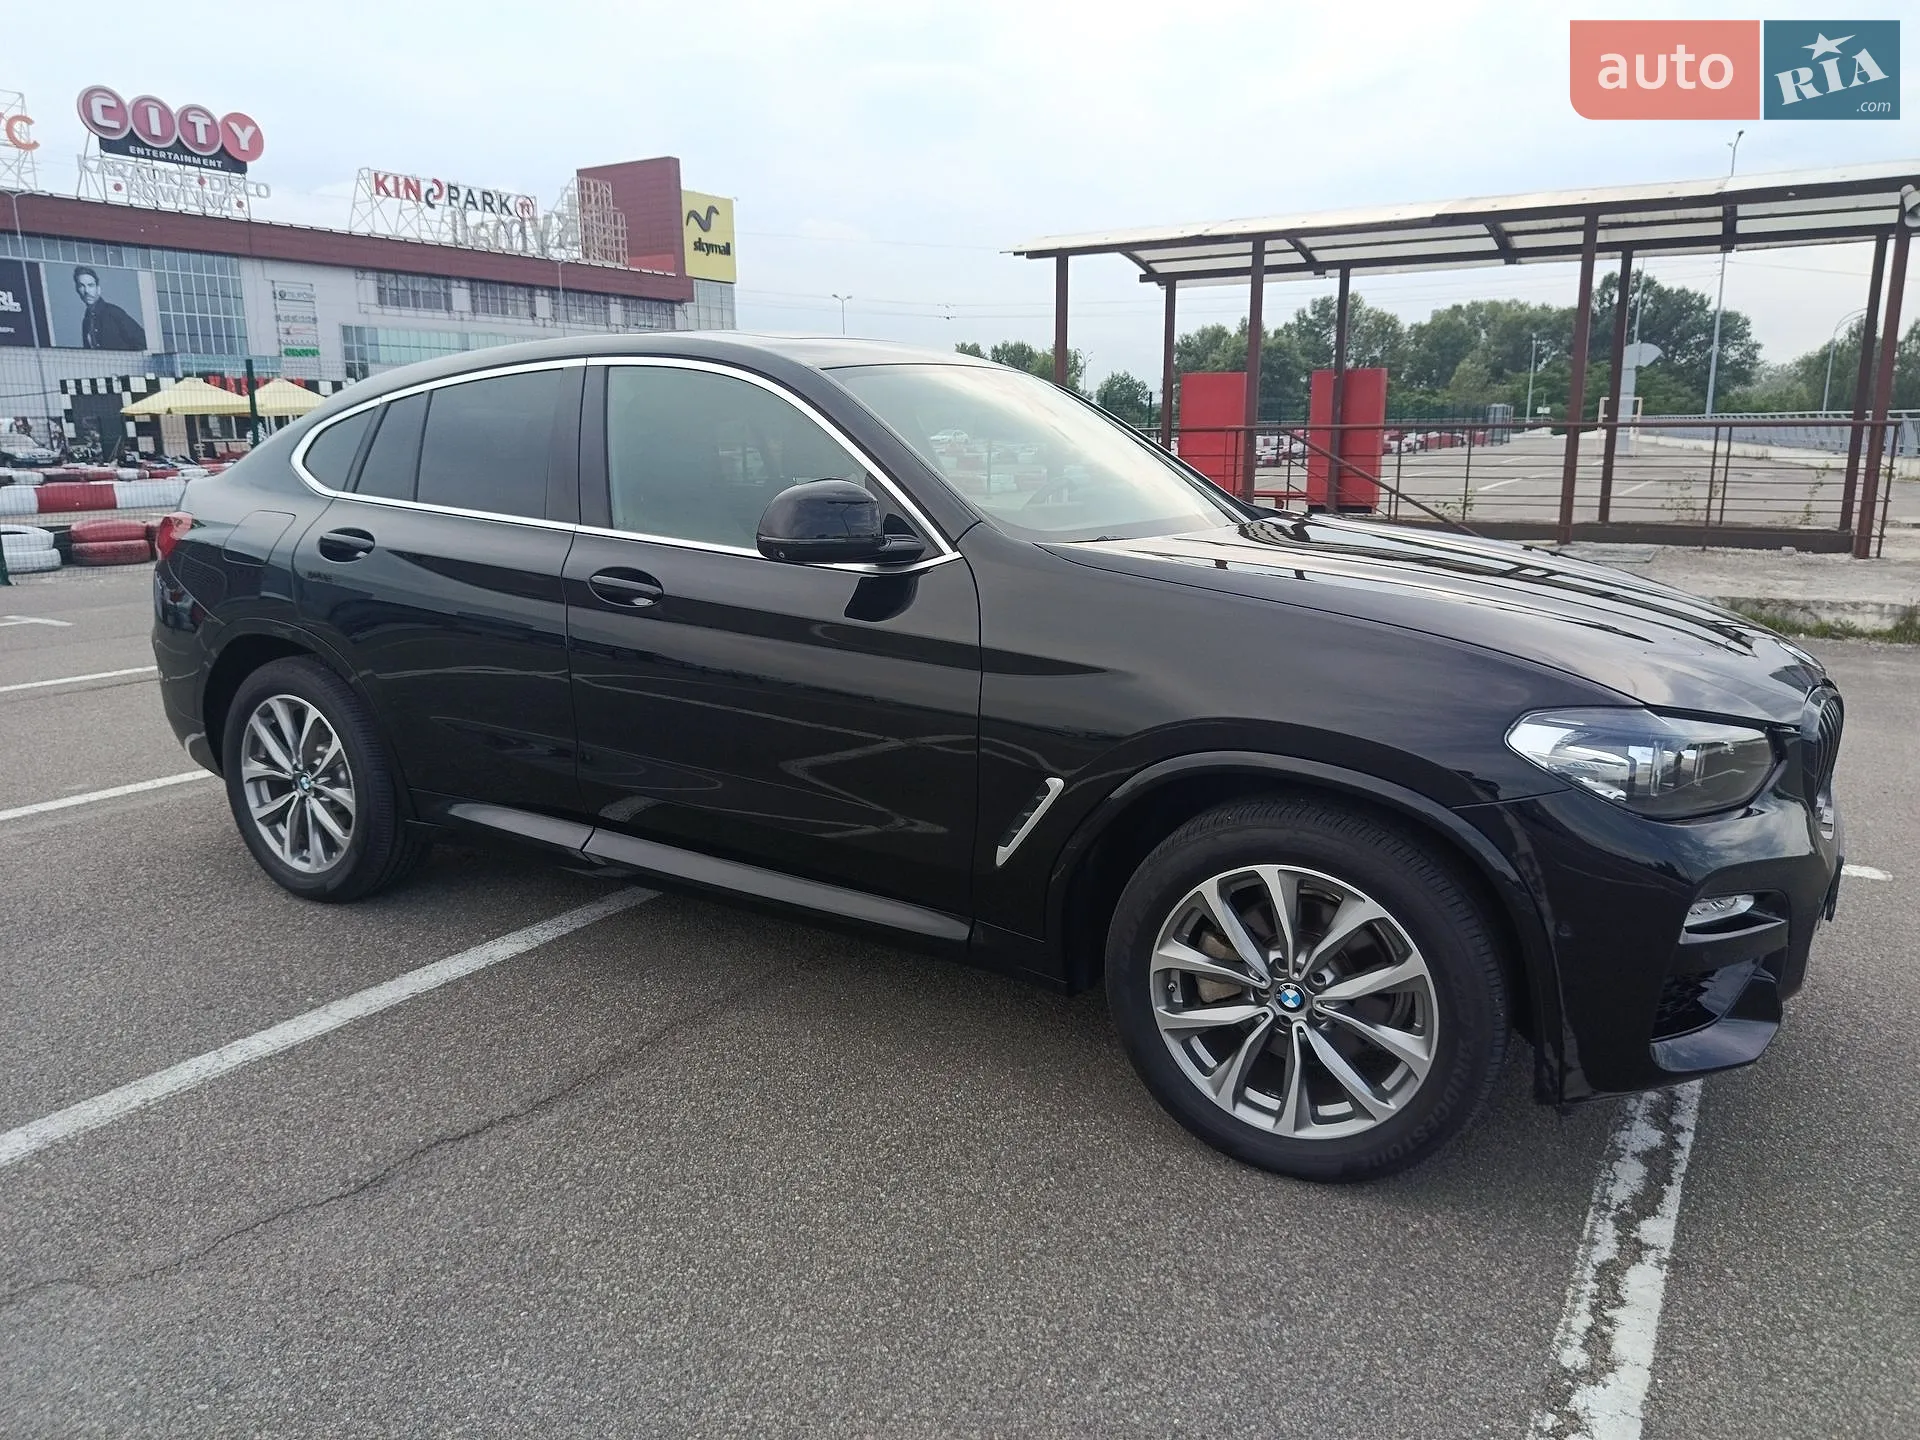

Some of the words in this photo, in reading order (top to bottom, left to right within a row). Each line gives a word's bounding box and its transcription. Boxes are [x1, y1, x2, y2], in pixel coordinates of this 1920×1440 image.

[90, 94, 257, 153] CITY
[128, 144, 224, 169] ENTERTAINMENT
[693, 237, 732, 257] skymall
